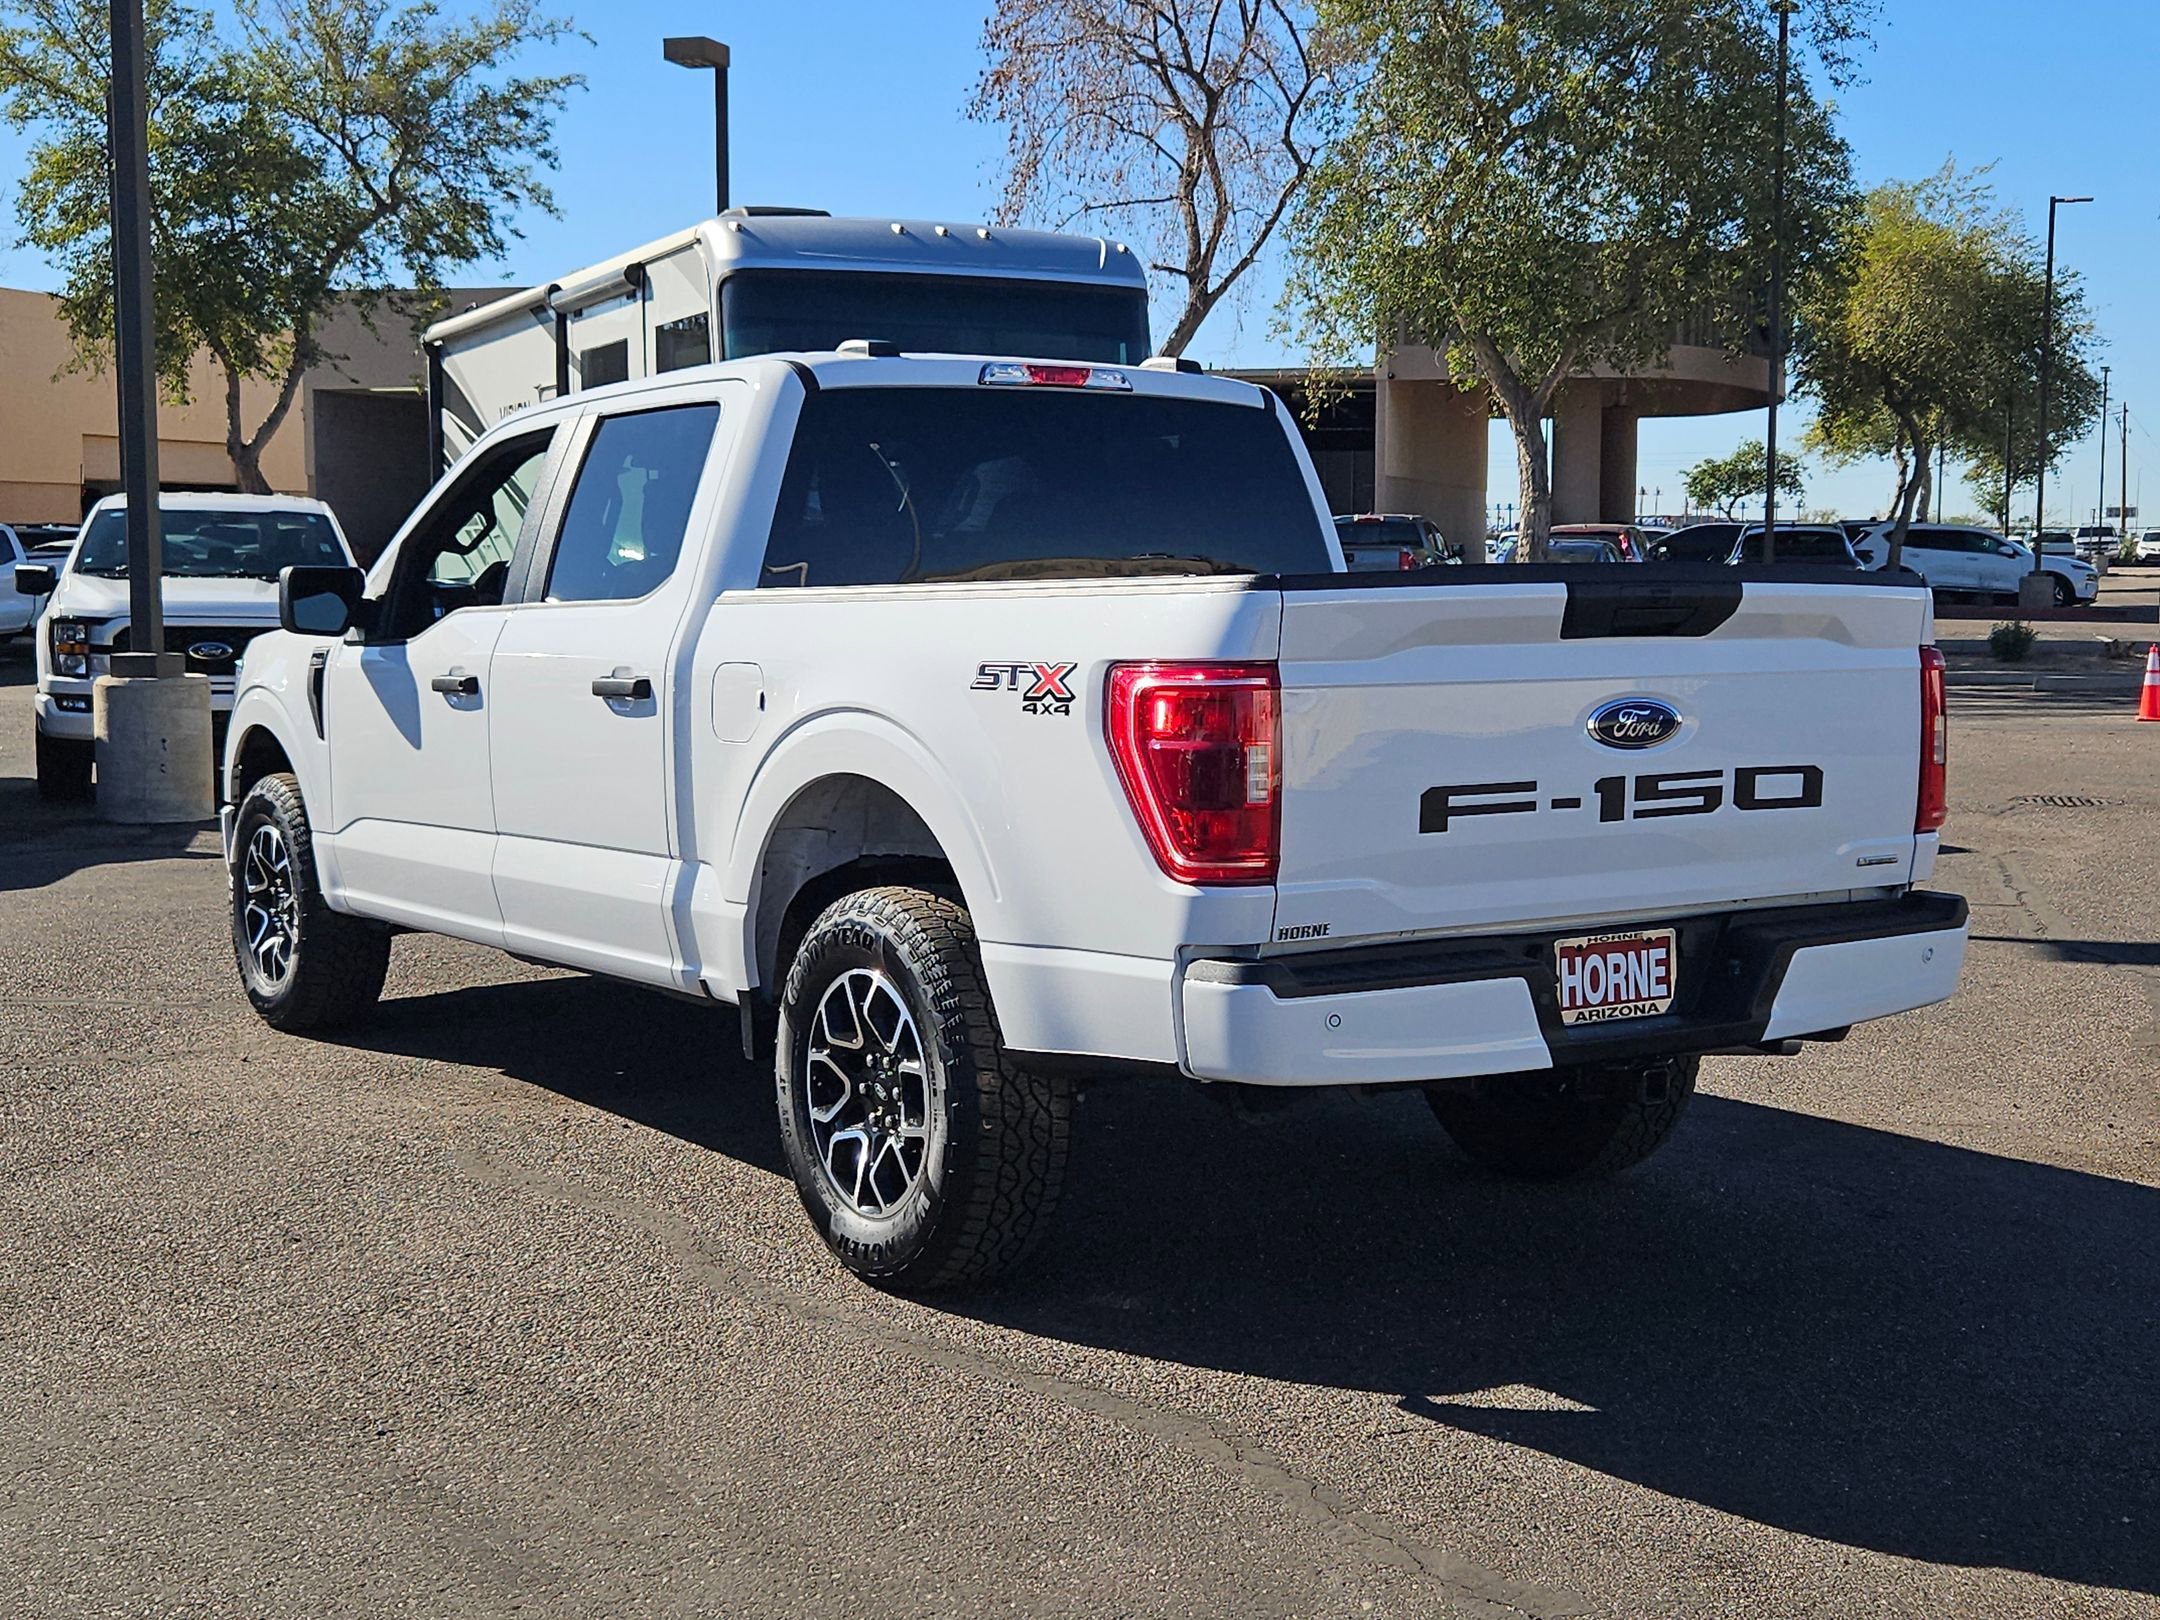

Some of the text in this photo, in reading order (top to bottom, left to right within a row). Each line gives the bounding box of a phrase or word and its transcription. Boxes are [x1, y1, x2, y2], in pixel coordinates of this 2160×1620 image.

[969, 661, 1078, 703] STX
[1613, 709, 1664, 738] Ford
[1419, 765, 1823, 834] F-150
[1277, 922, 1331, 941] HORNE
[1587, 932, 1643, 944] HORNE
[1561, 948, 1668, 1008] HORNE
[1574, 1002, 1660, 1023] ARIZONA
